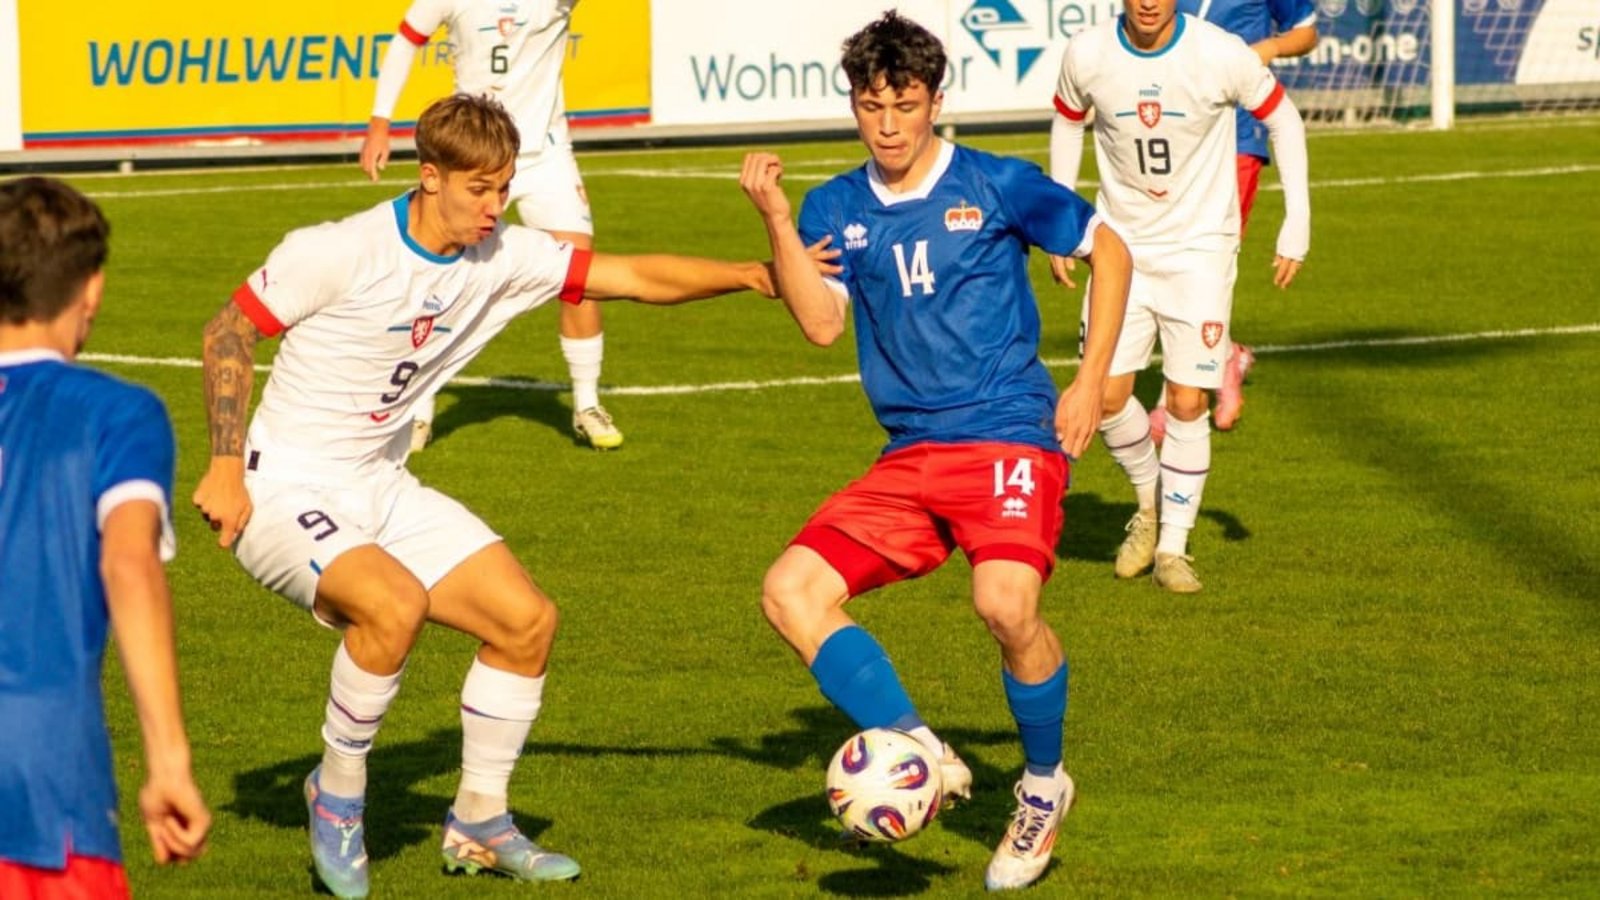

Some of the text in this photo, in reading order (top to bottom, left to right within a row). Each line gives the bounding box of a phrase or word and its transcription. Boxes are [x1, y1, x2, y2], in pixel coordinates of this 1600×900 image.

[491, 44, 509, 74] 6
[1134, 138, 1172, 175] 19
[892, 240, 936, 297] 14
[381, 361, 418, 404] 9
[994, 458, 1036, 498] 14
[297, 510, 339, 541] 9
